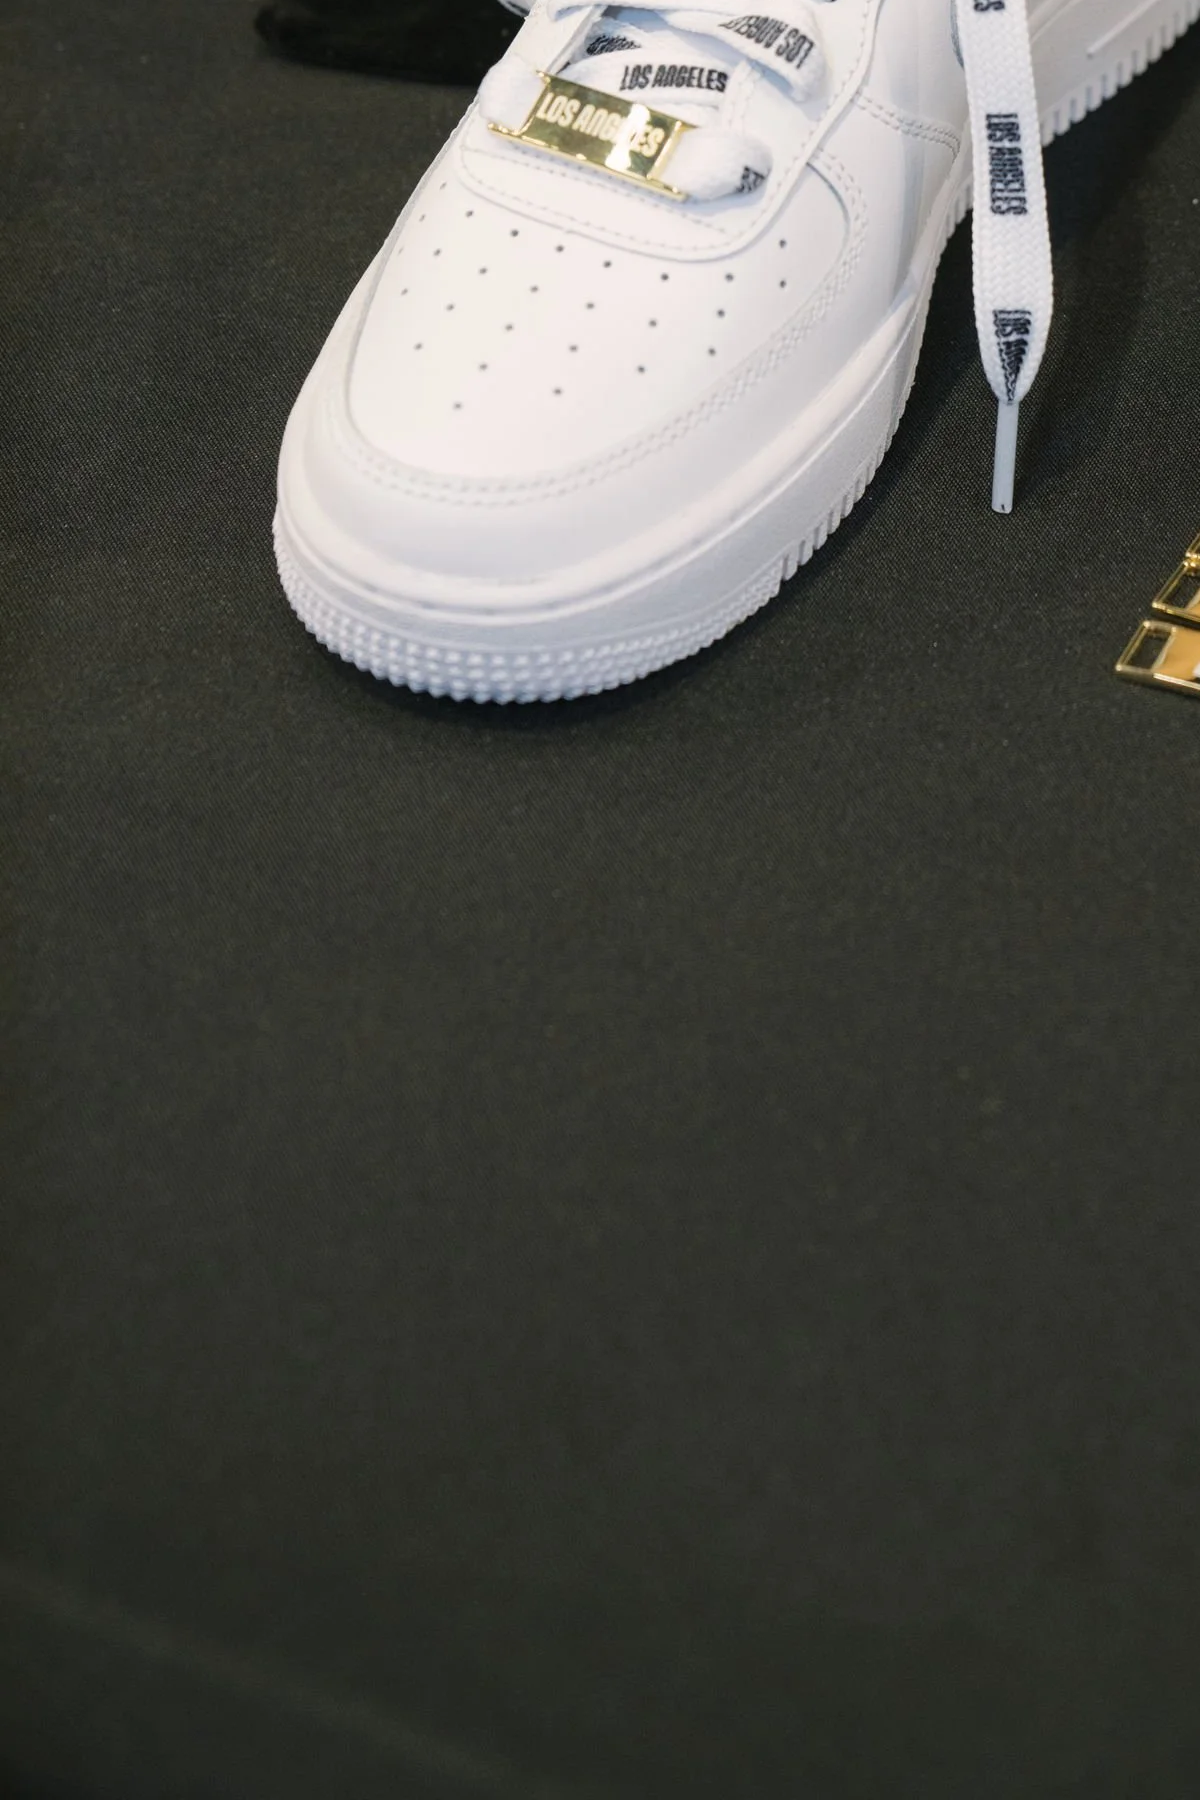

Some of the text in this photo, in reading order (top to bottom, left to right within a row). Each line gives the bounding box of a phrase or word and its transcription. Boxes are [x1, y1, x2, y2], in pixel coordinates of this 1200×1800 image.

[775, 28, 815, 70] LOS
[619, 64, 729, 93] LOS ANGELES
[536, 92, 581, 128] LOS
[986, 113, 1027, 215] LOS ANGELES
[992, 310, 1032, 338] LOS
